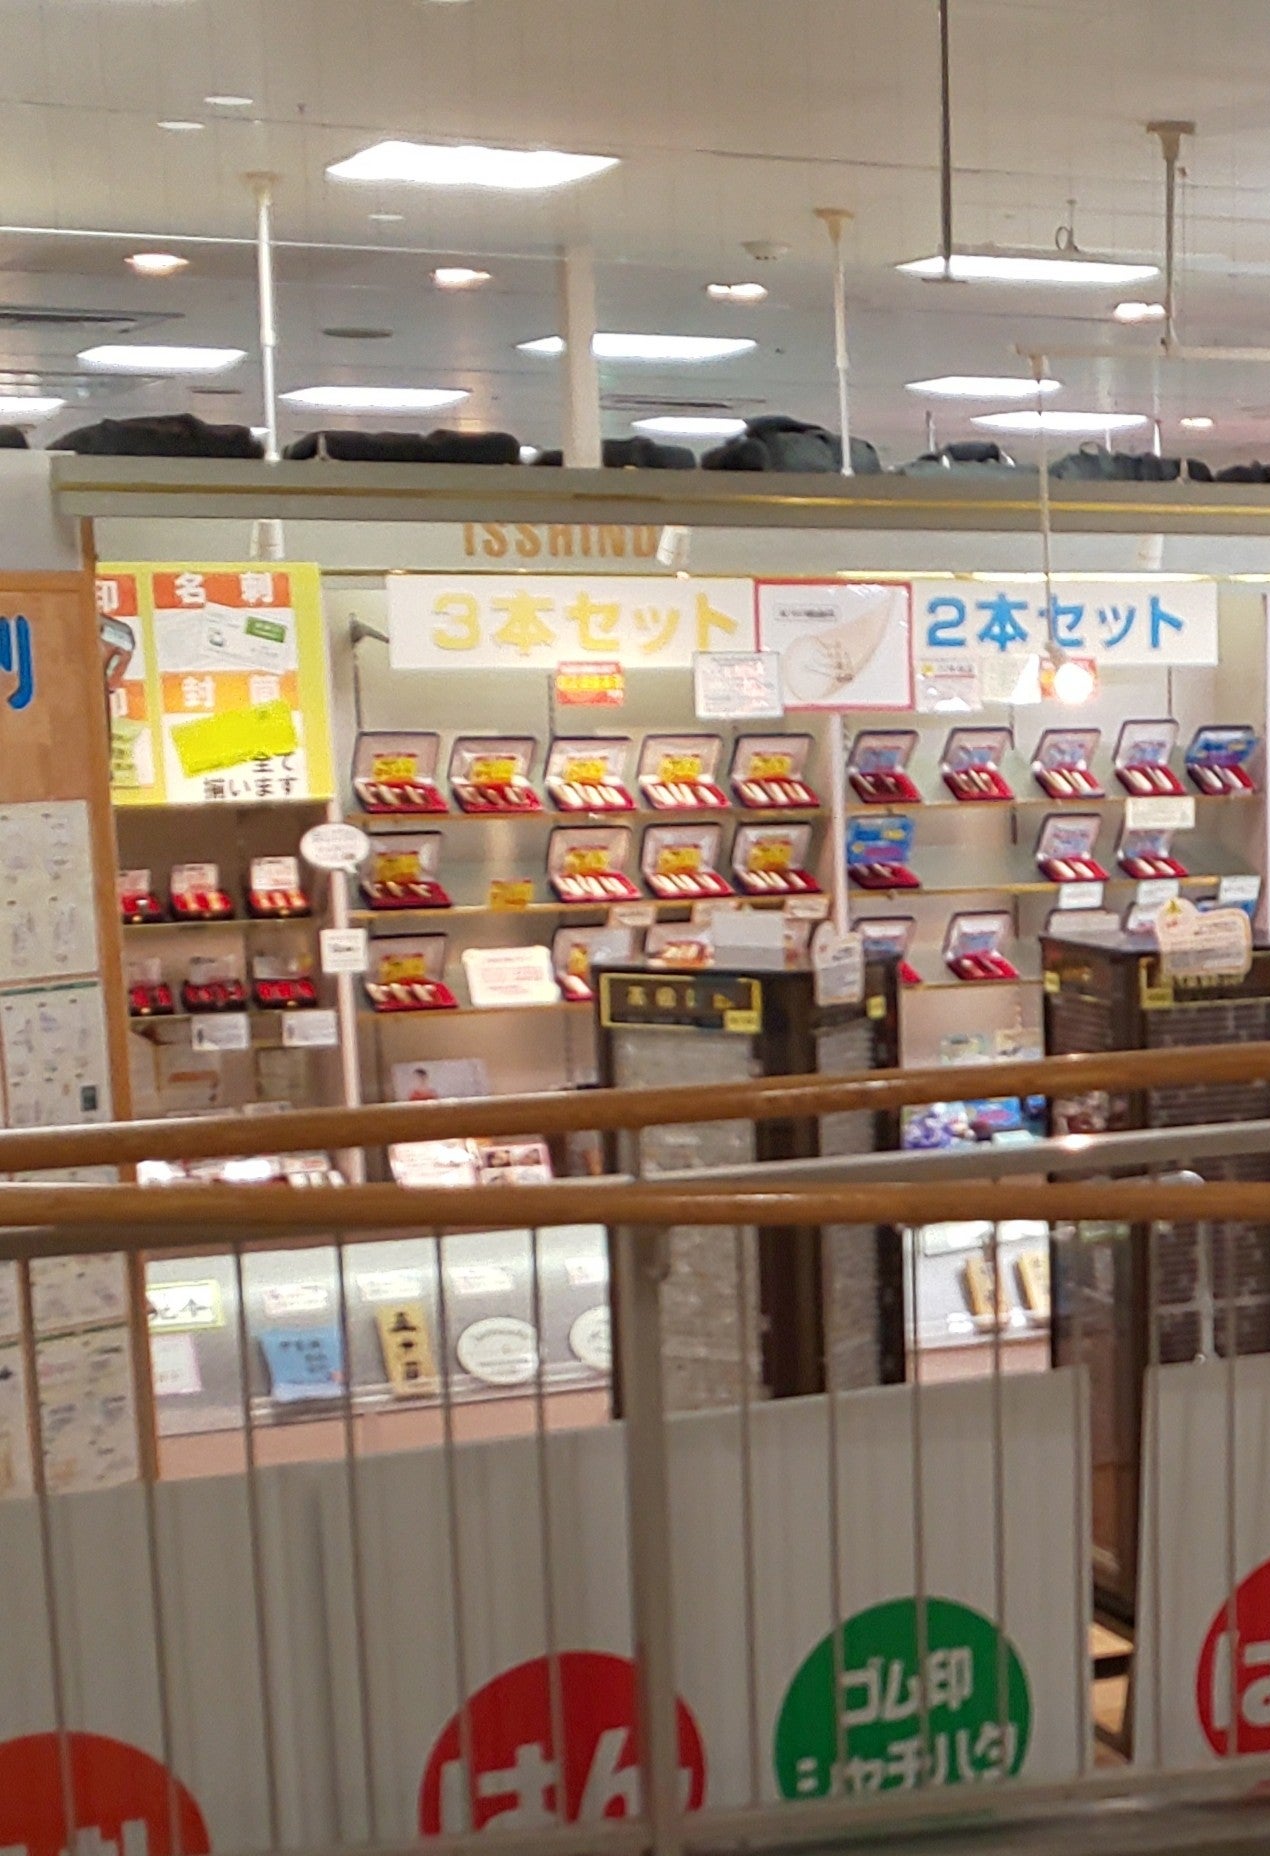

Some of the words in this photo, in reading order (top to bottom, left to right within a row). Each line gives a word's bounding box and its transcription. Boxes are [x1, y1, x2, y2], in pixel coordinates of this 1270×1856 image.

[462, 523, 688, 557] ISSHIND
[432, 588, 738, 655] 3本セット
[926, 592, 1185, 652] 2本セット
[838, 1645, 973, 1727] ゴム印
